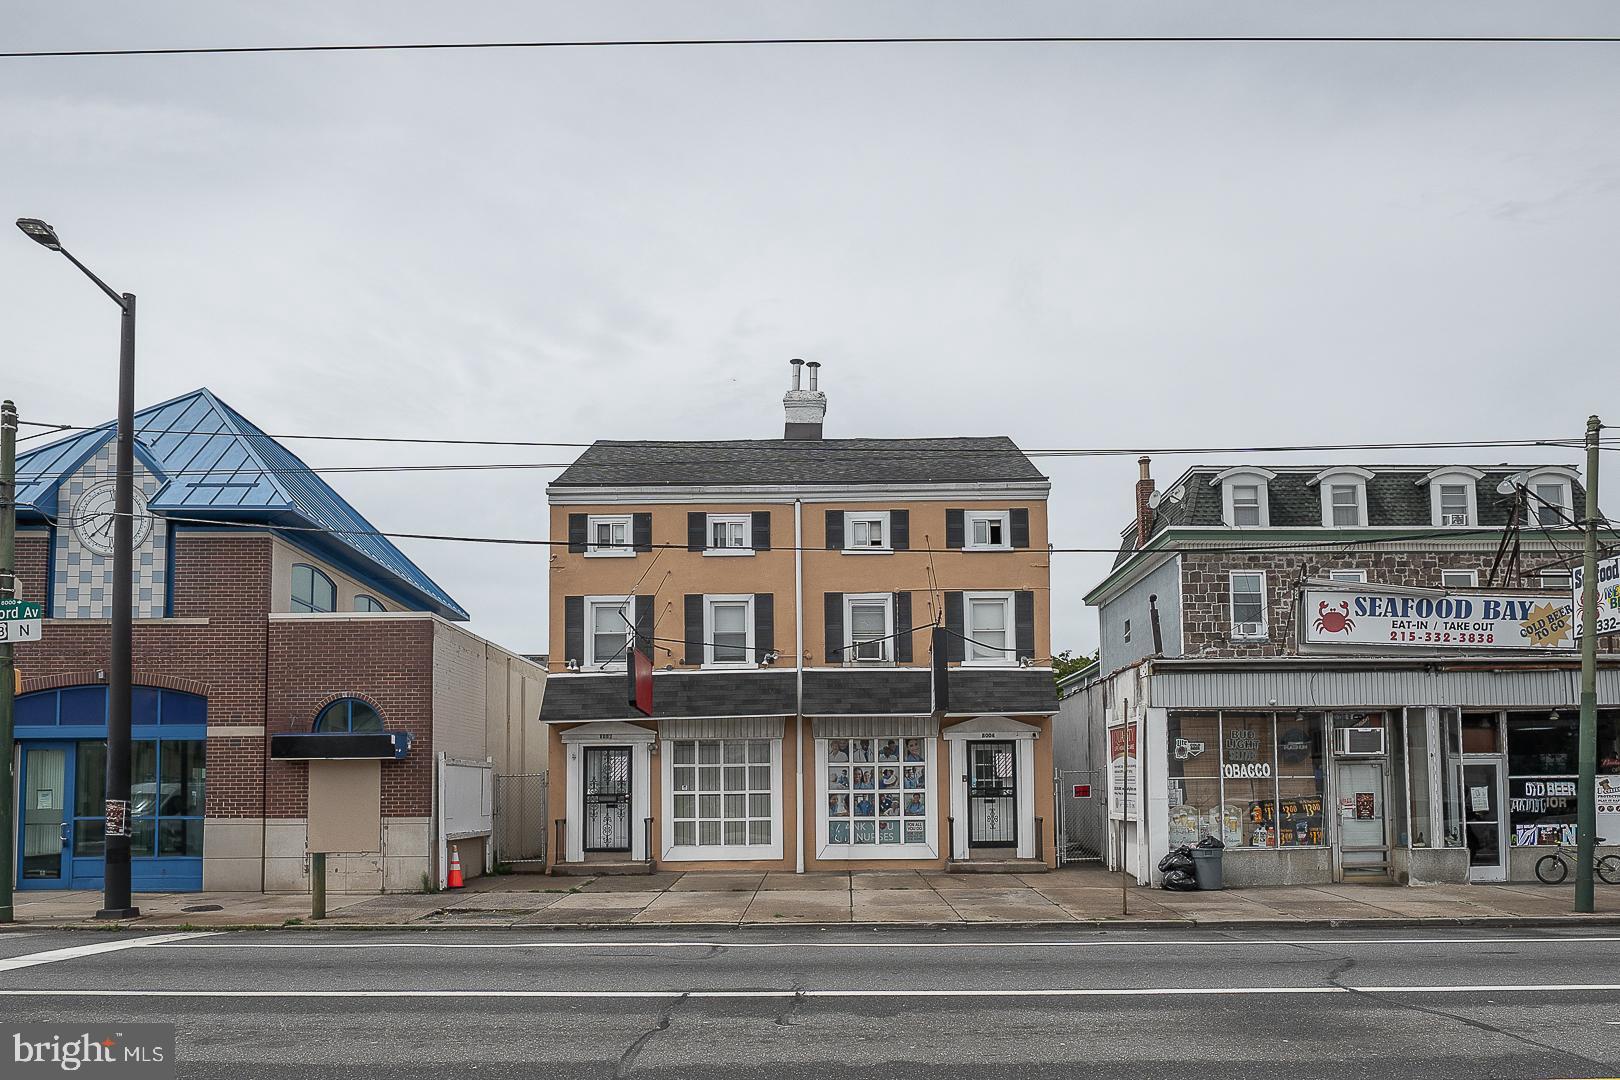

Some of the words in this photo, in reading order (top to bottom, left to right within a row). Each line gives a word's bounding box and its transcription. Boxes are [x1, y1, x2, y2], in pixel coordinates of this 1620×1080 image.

[1574, 558, 1619, 589] Sood
[23, 607, 39, 618] Av
[1354, 596, 1473, 620] SEAFOOD
[1482, 600, 1535, 621] BAY
[1391, 620, 1428, 630] EAT-IN
[1443, 621, 1470, 631] TAKE
[1472, 622, 1495, 632] OUT
[1520, 618, 1546, 638] COLD
[1546, 604, 1573, 624] BEER
[19, 624, 30, 637] N
[1534, 629, 1550, 641] TO
[1551, 619, 1565, 633] GO
[1390, 631, 1494, 644] 215-332-3838
[1230, 730, 1256, 740] BUD
[1225, 739, 1261, 750] LIGHT
[1547, 782, 1577, 796] BEER
